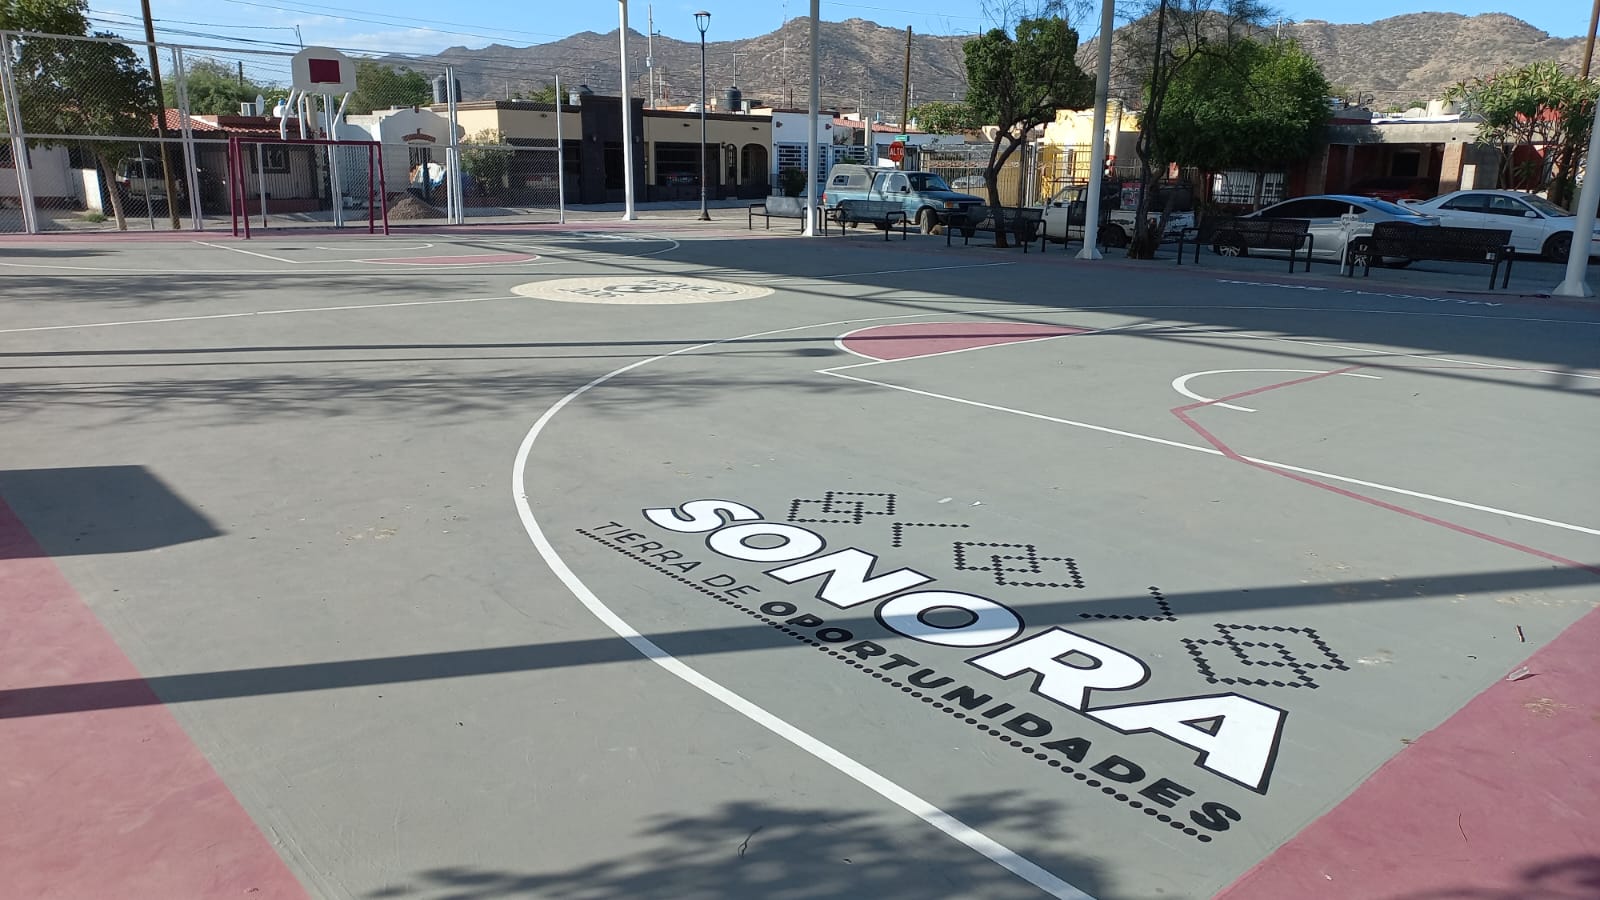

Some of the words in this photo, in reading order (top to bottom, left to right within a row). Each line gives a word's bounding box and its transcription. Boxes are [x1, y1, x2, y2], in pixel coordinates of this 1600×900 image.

[889, 147, 904, 156] ALTO
[593, 521, 702, 574] TIERRA
[702, 573, 761, 600] DE
[759, 600, 1242, 832] OPORTUNIDADES
[642, 498, 1289, 795] SONORA
